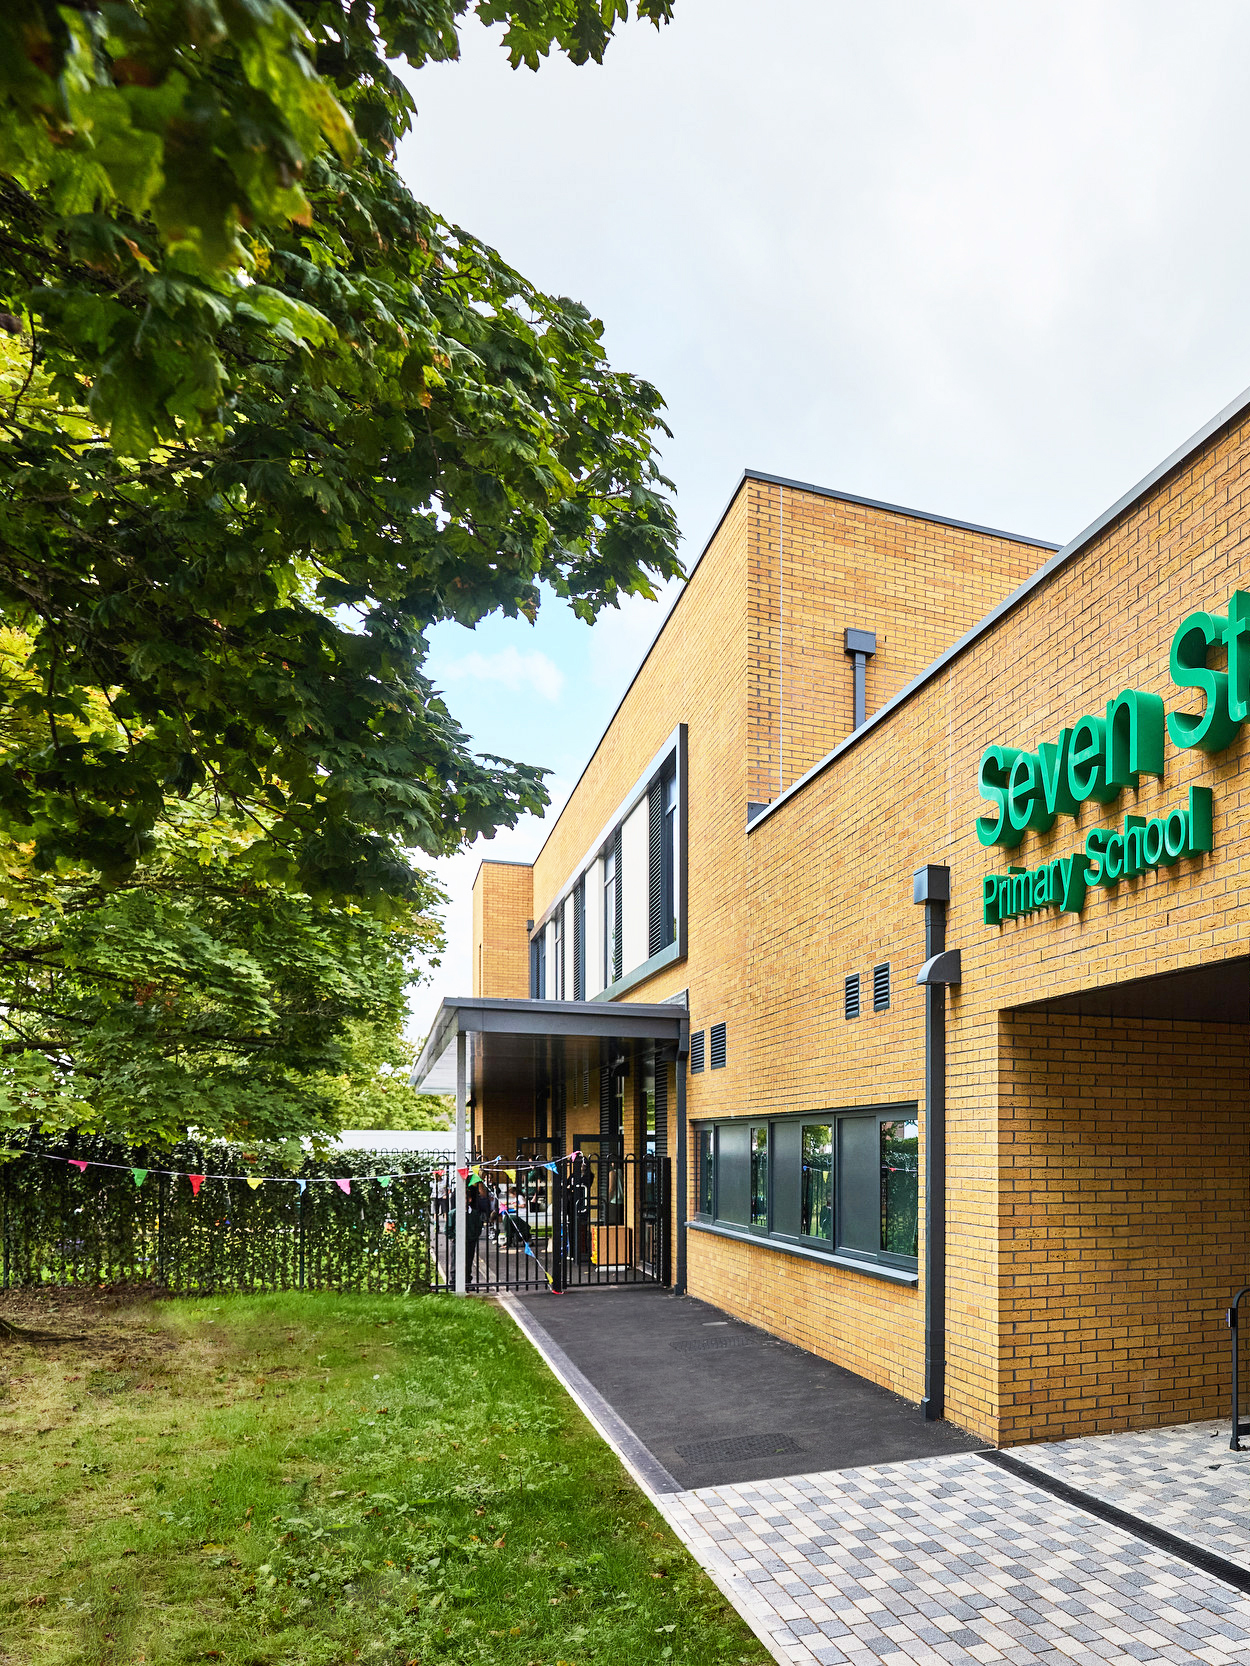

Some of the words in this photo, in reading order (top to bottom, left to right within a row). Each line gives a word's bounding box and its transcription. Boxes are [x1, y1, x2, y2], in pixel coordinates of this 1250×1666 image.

[976, 689, 1164, 848] Seven
[983, 853, 1091, 925] Primary
[1084, 786, 1213, 887] School
